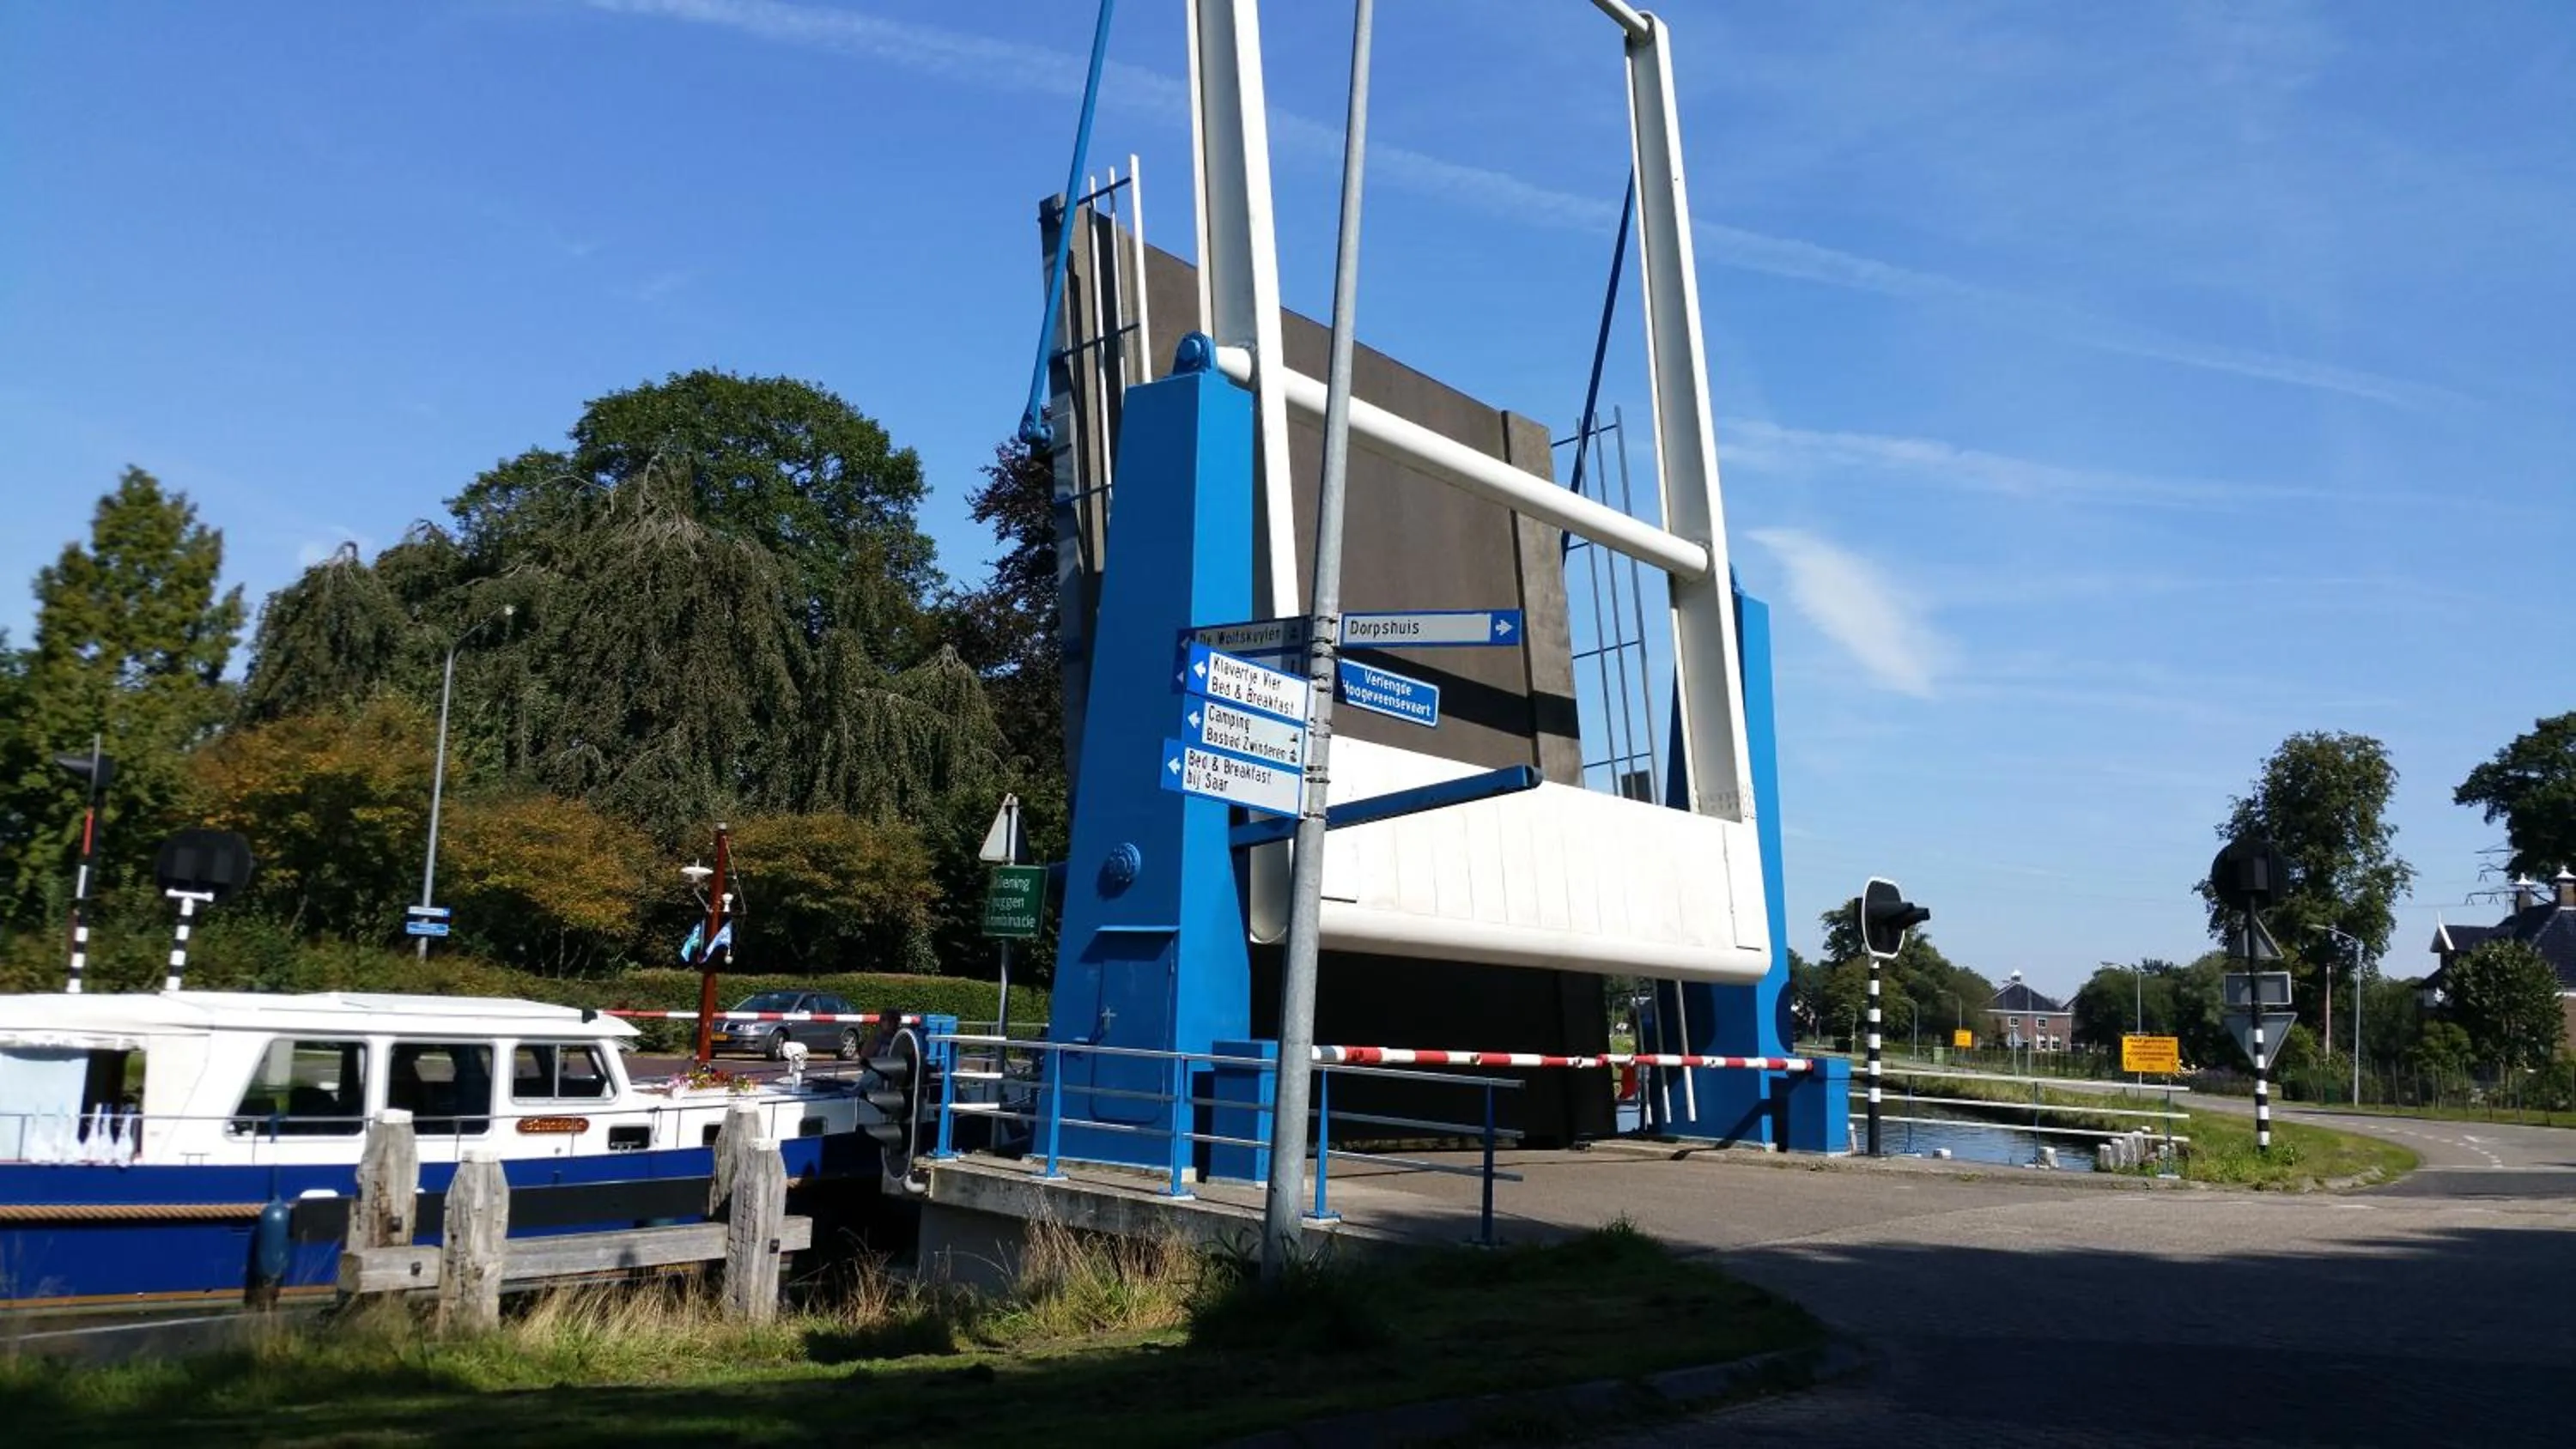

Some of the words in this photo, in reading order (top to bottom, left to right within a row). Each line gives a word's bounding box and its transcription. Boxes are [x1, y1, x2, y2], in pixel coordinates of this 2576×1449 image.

[1351, 620, 1419, 637] Dorpshuis
[1213, 657, 1258, 686] Klavertje
[1263, 671, 1281, 690] Vier
[1364, 670, 1413, 696] Verlengde
[1212, 676, 1230, 696] Bed
[1234, 684, 1241, 700] &
[1246, 688, 1295, 715] Breakfast
[1208, 705, 1250, 733] Camping
[1206, 727, 1240, 749] Bosbad
[1186, 769, 1200, 790] bij
[1205, 773, 1229, 791] Saar
[1188, 750, 1207, 769] Bed
[1212, 756, 1218, 772] &
[1224, 759, 1272, 785] Breakfast
